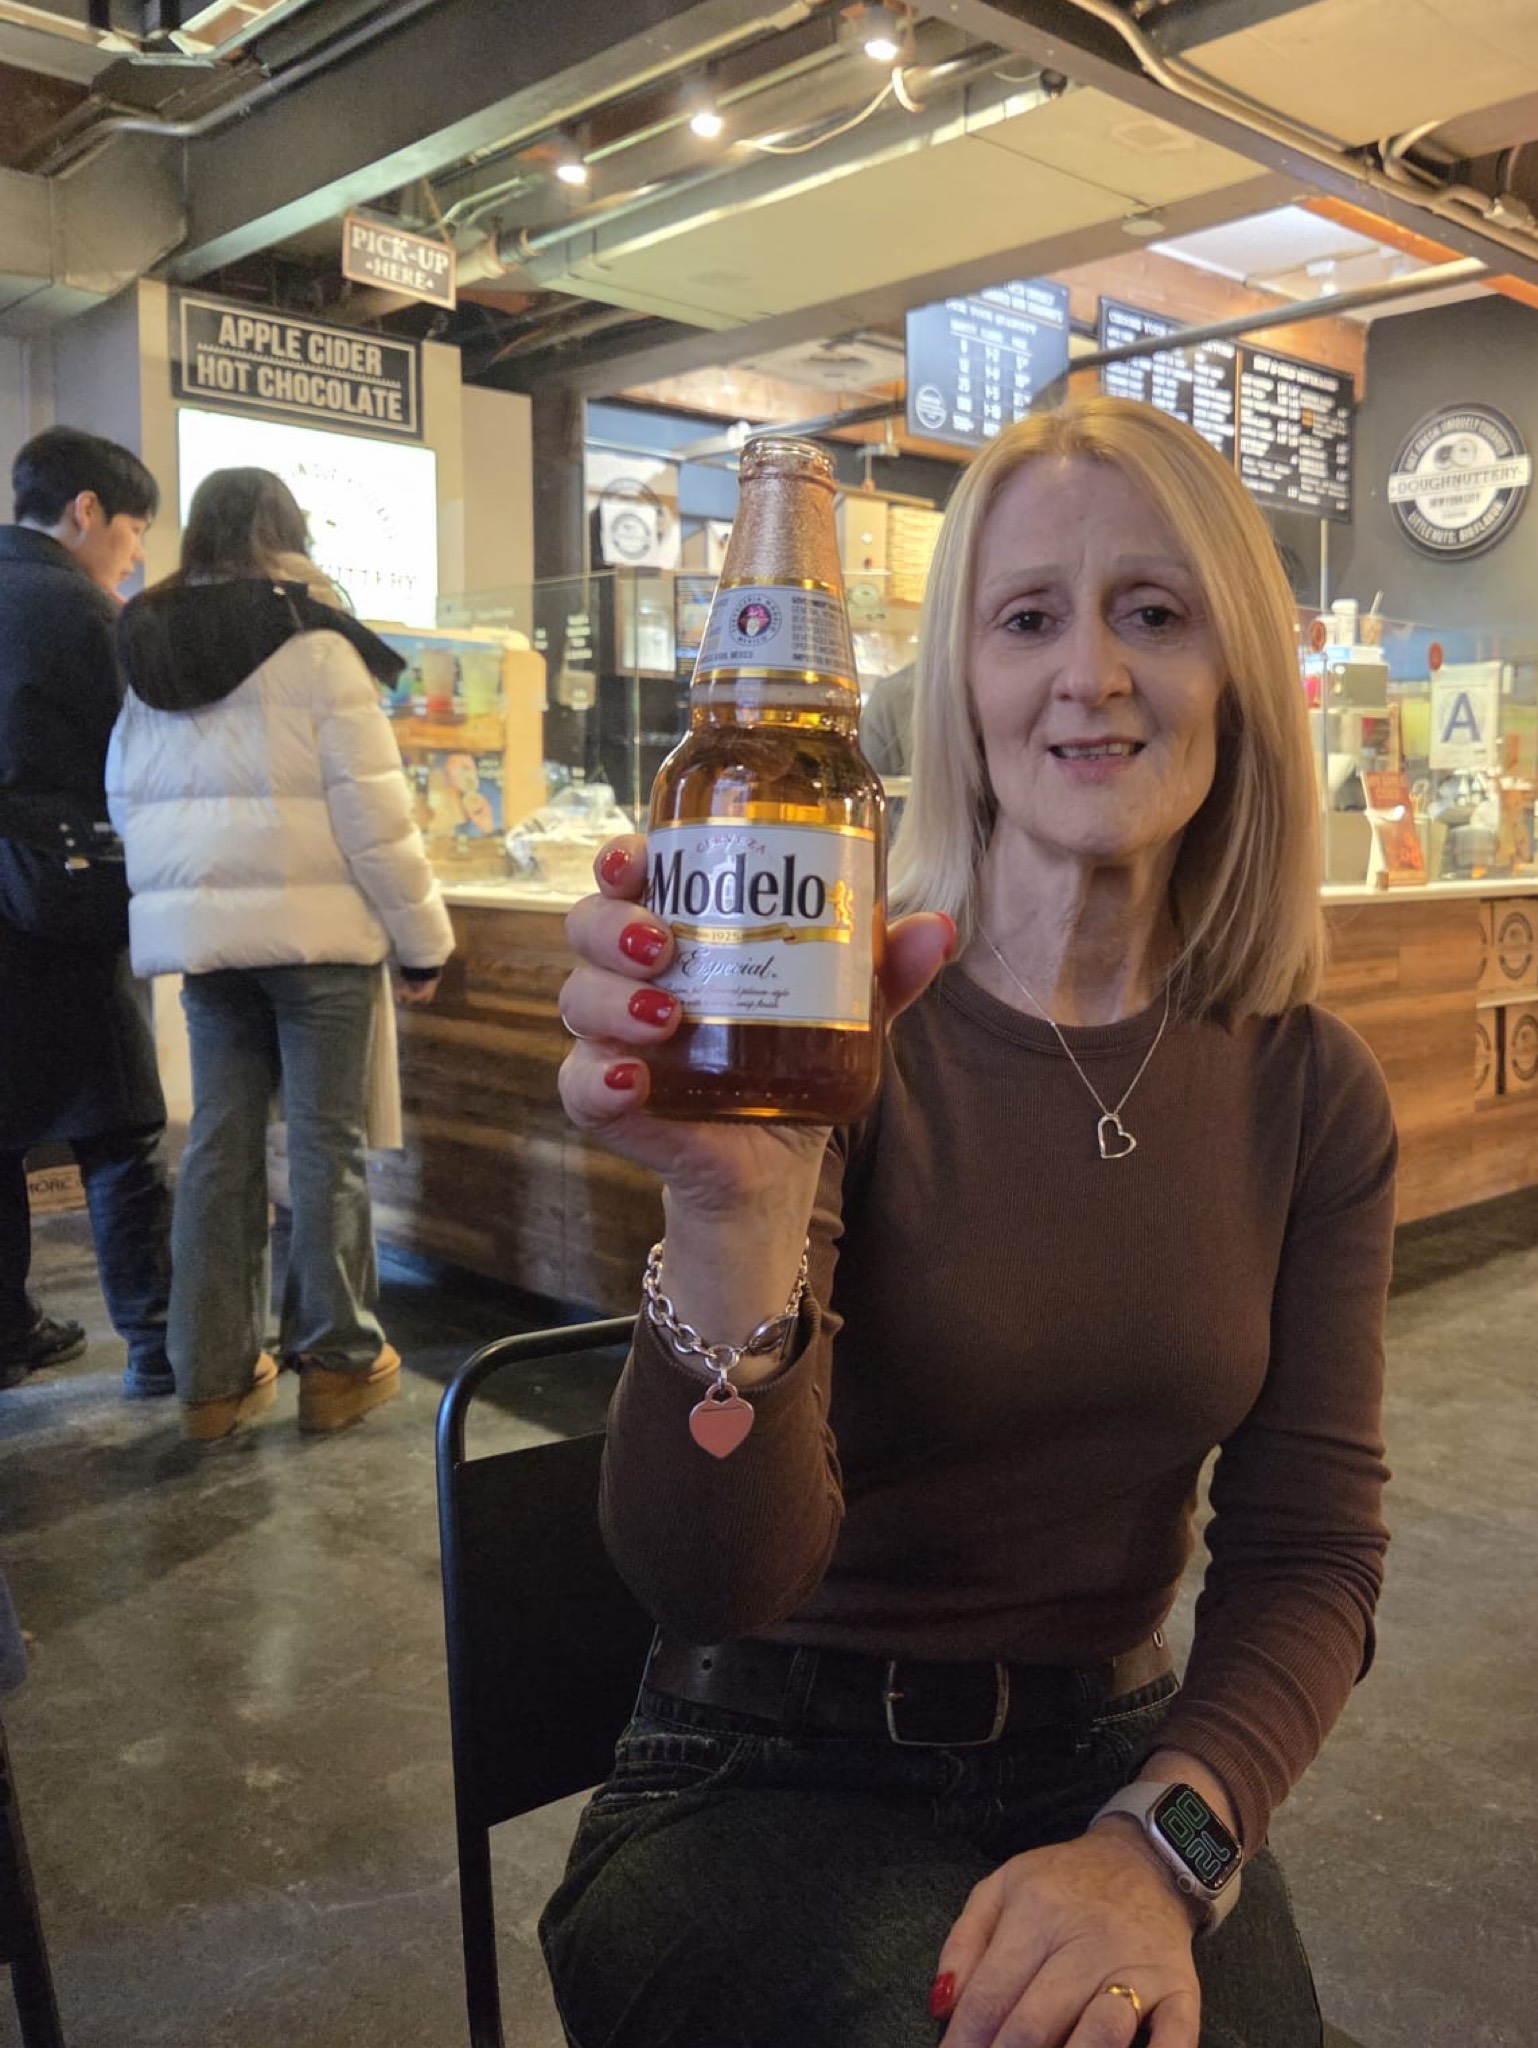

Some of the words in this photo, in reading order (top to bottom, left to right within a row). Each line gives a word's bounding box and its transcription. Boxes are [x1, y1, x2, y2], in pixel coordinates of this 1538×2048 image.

[352, 225, 449, 274] PICK-UP
[218, 315, 301, 359] APPLE
[308, 333, 382, 377] CIDER
[197, 354, 251, 392] HOT
[257, 366, 402, 421] CHOCOLATE
[1397, 465, 1518, 495] DOUGHNUTTERY
[1442, 691, 1481, 743] A
[647, 848, 825, 919] Modelo
[1160, 1790, 1211, 1848] 00
[1186, 1830, 1231, 1880] 12
